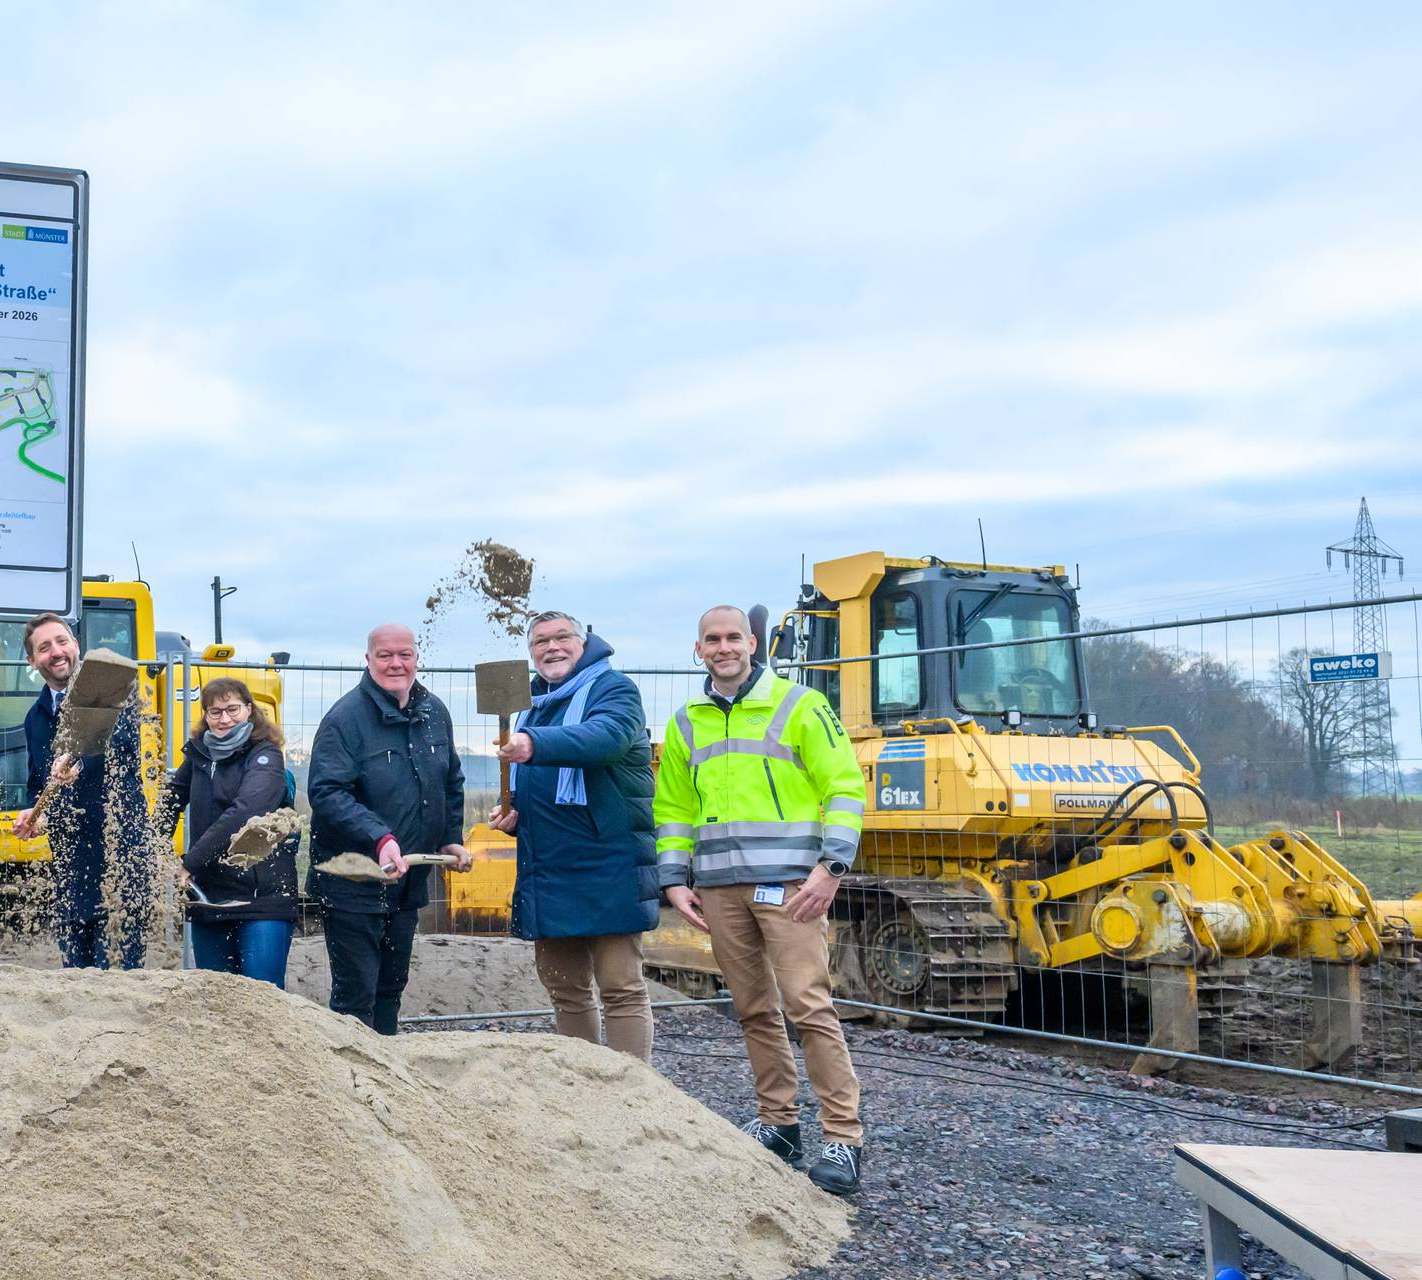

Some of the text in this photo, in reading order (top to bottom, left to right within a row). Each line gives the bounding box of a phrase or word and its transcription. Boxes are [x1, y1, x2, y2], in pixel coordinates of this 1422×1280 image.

[35, 232, 66, 241] MÜNSTER
[12, 310, 38, 321] 2026
[1312, 656, 1376, 671] aweko
[1010, 759, 1144, 784] KOMATSU
[881, 773, 892, 786] D
[880, 787, 920, 805] 61EX
